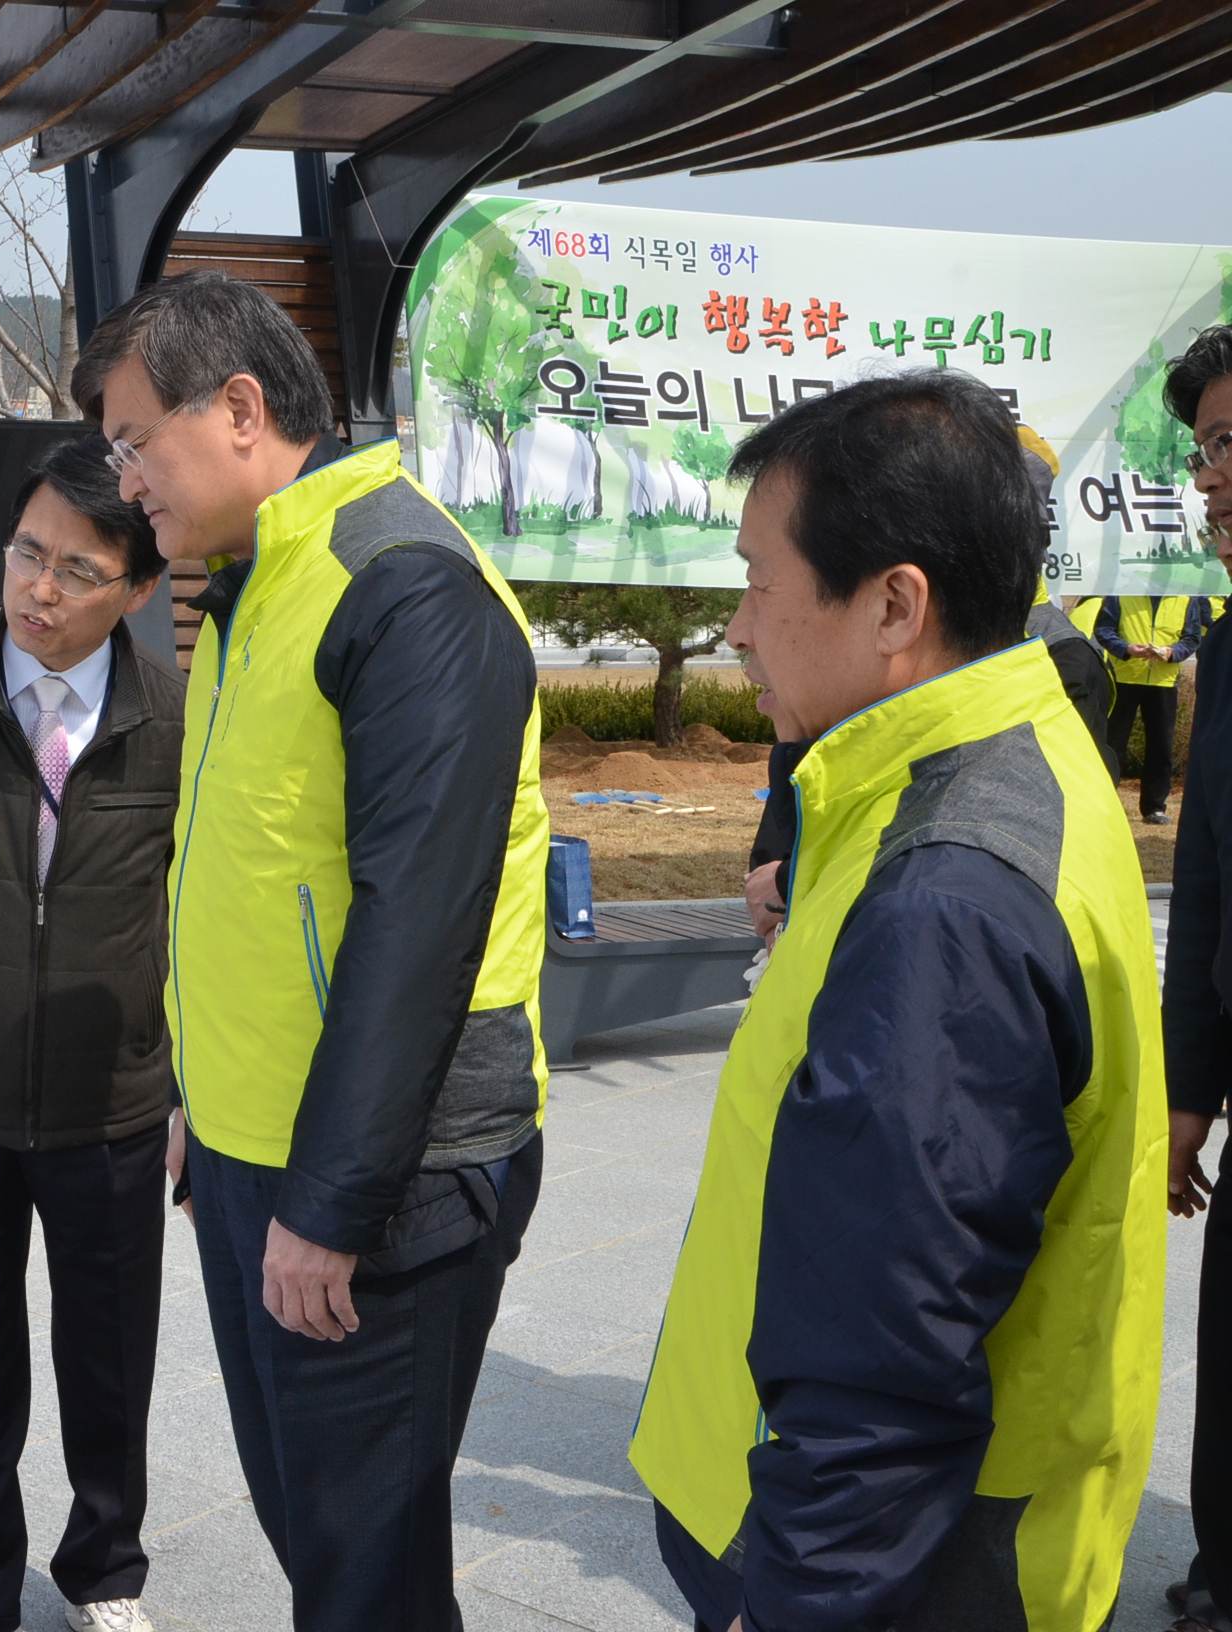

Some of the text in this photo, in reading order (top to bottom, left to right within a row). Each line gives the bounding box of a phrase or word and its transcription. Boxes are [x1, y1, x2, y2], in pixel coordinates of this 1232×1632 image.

[527, 227, 759, 276] 제68회 식목일 행사
[535, 278, 1052, 367] 국민이 행복한 나무심기
[535, 359, 711, 433] 오늘의
[1080, 473, 1184, 533] 여는
